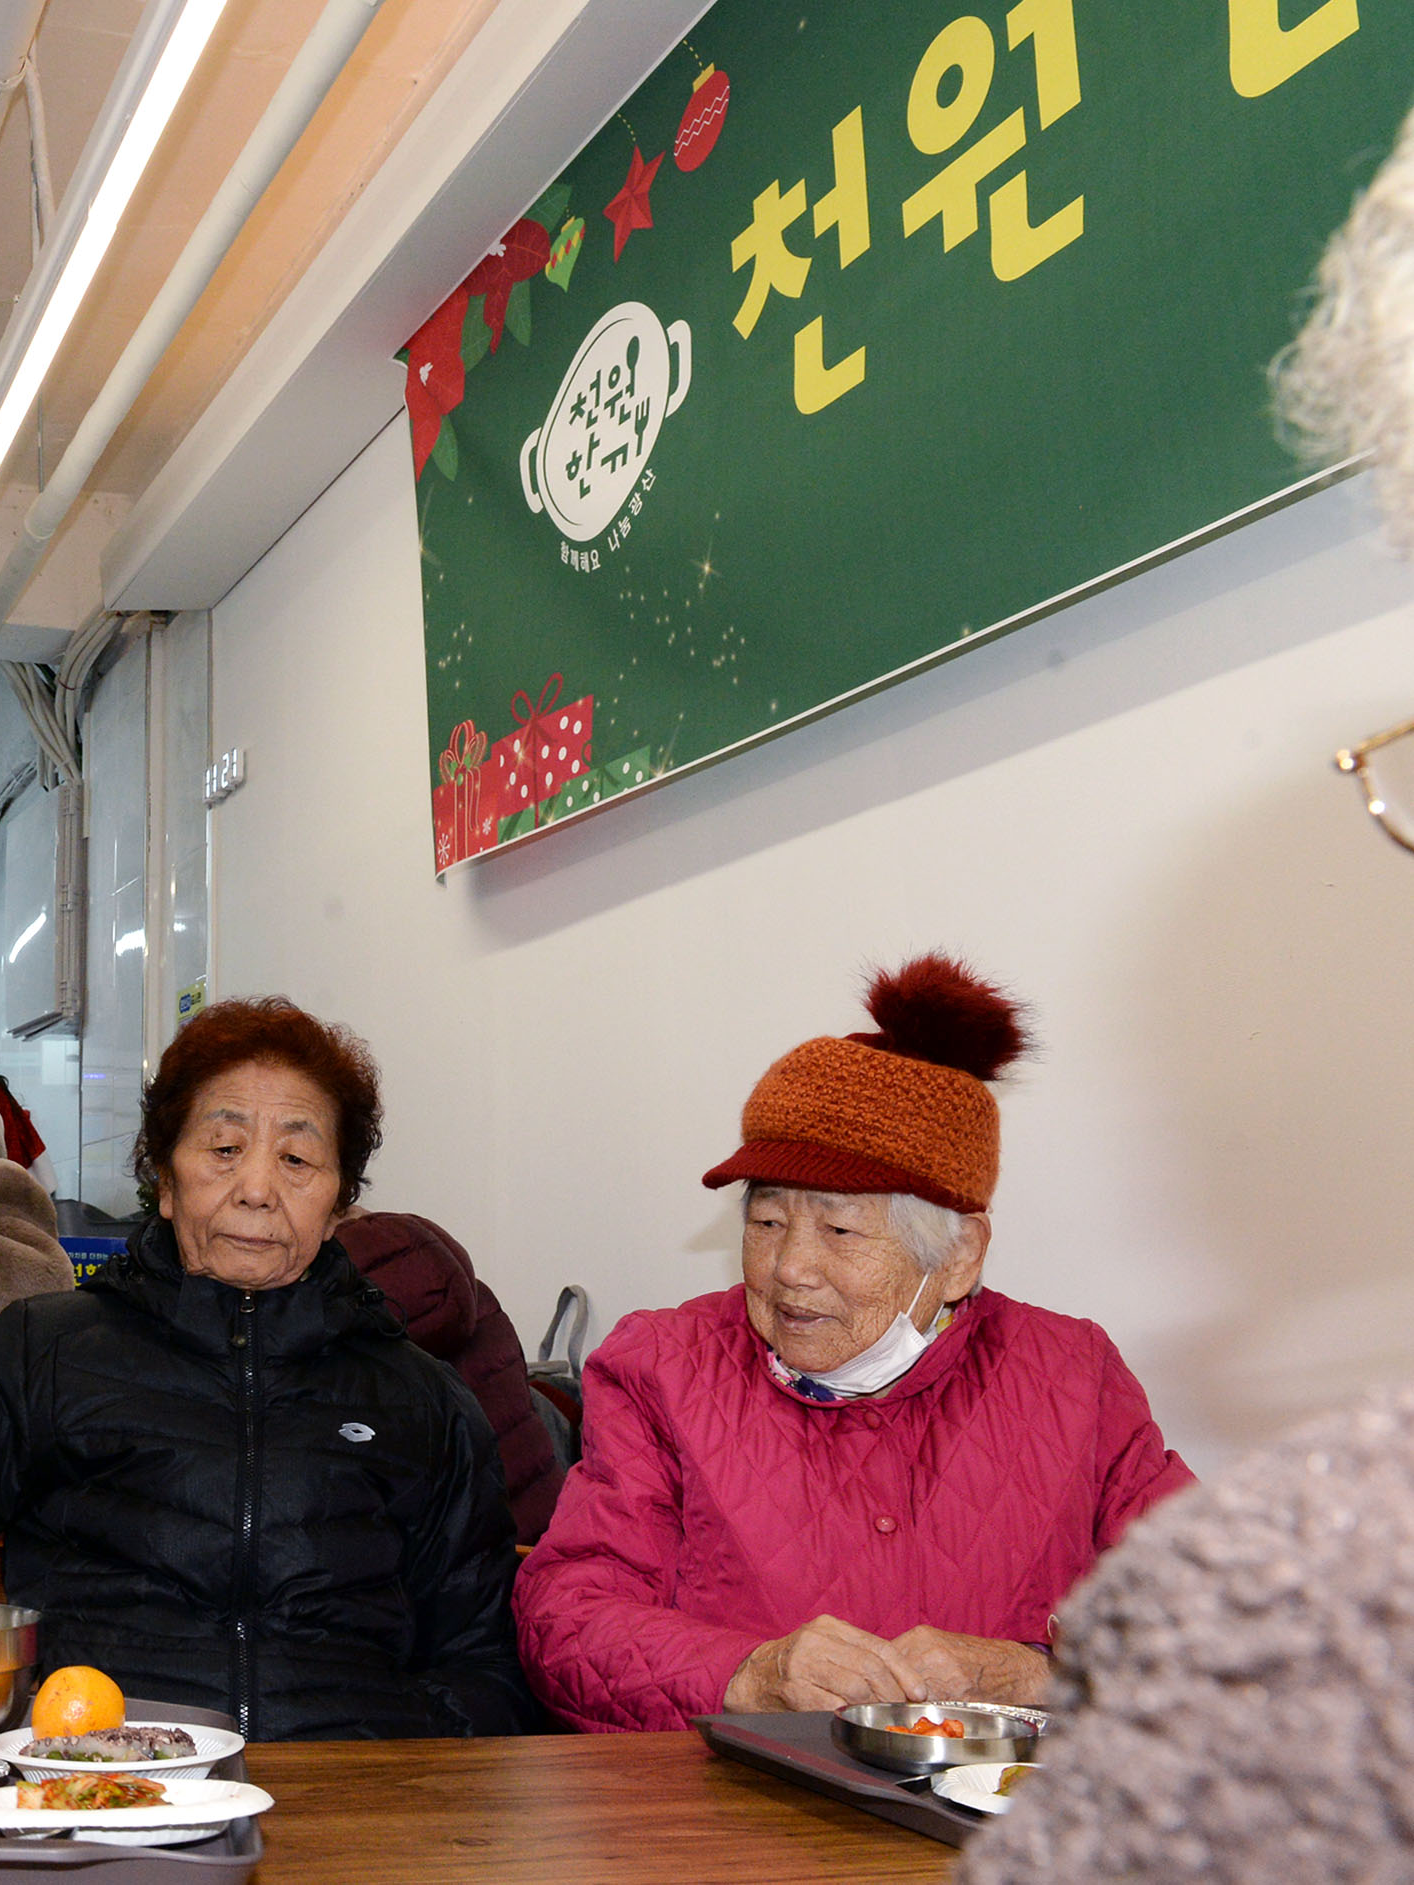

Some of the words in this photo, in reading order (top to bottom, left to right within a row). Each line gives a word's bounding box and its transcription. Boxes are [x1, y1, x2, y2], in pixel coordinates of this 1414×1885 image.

[731, 0, 1084, 415] 천원
[569, 336, 640, 430] 천원
[565, 397, 650, 499] 한끼
[560, 540, 601, 573] 함께해요
